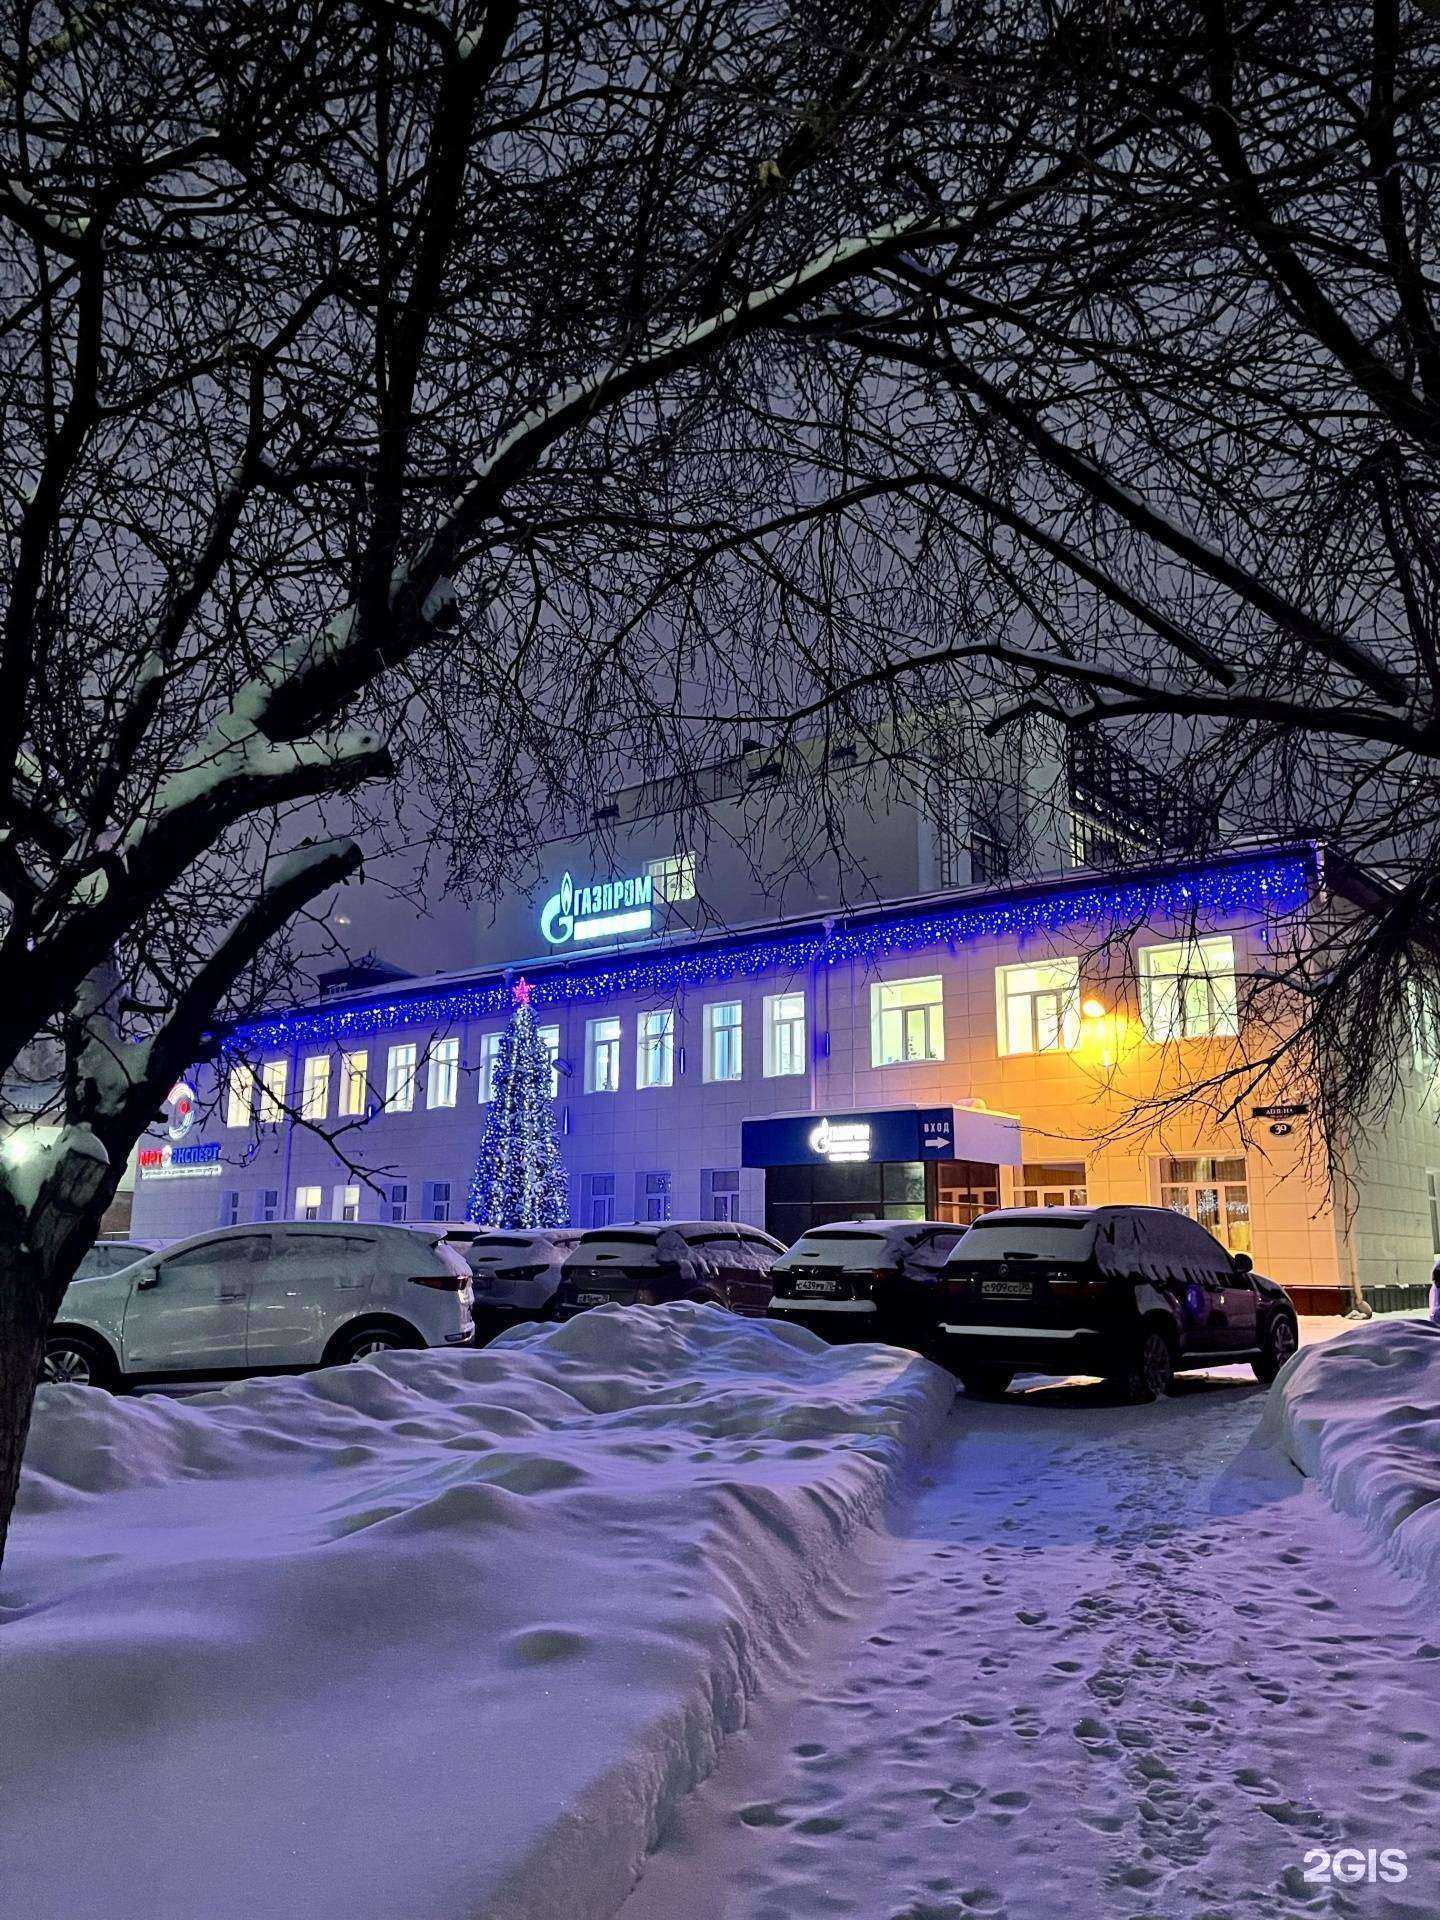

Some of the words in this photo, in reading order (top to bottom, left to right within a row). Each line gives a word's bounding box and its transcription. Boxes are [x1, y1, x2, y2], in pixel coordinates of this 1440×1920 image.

[574, 875, 651, 916] ГАЗПРОМ
[923, 1122, 950, 1134] ВХОД
[139, 1150, 163, 1168] МРТ
[171, 1145, 219, 1165] ЭКСПЕРТ
